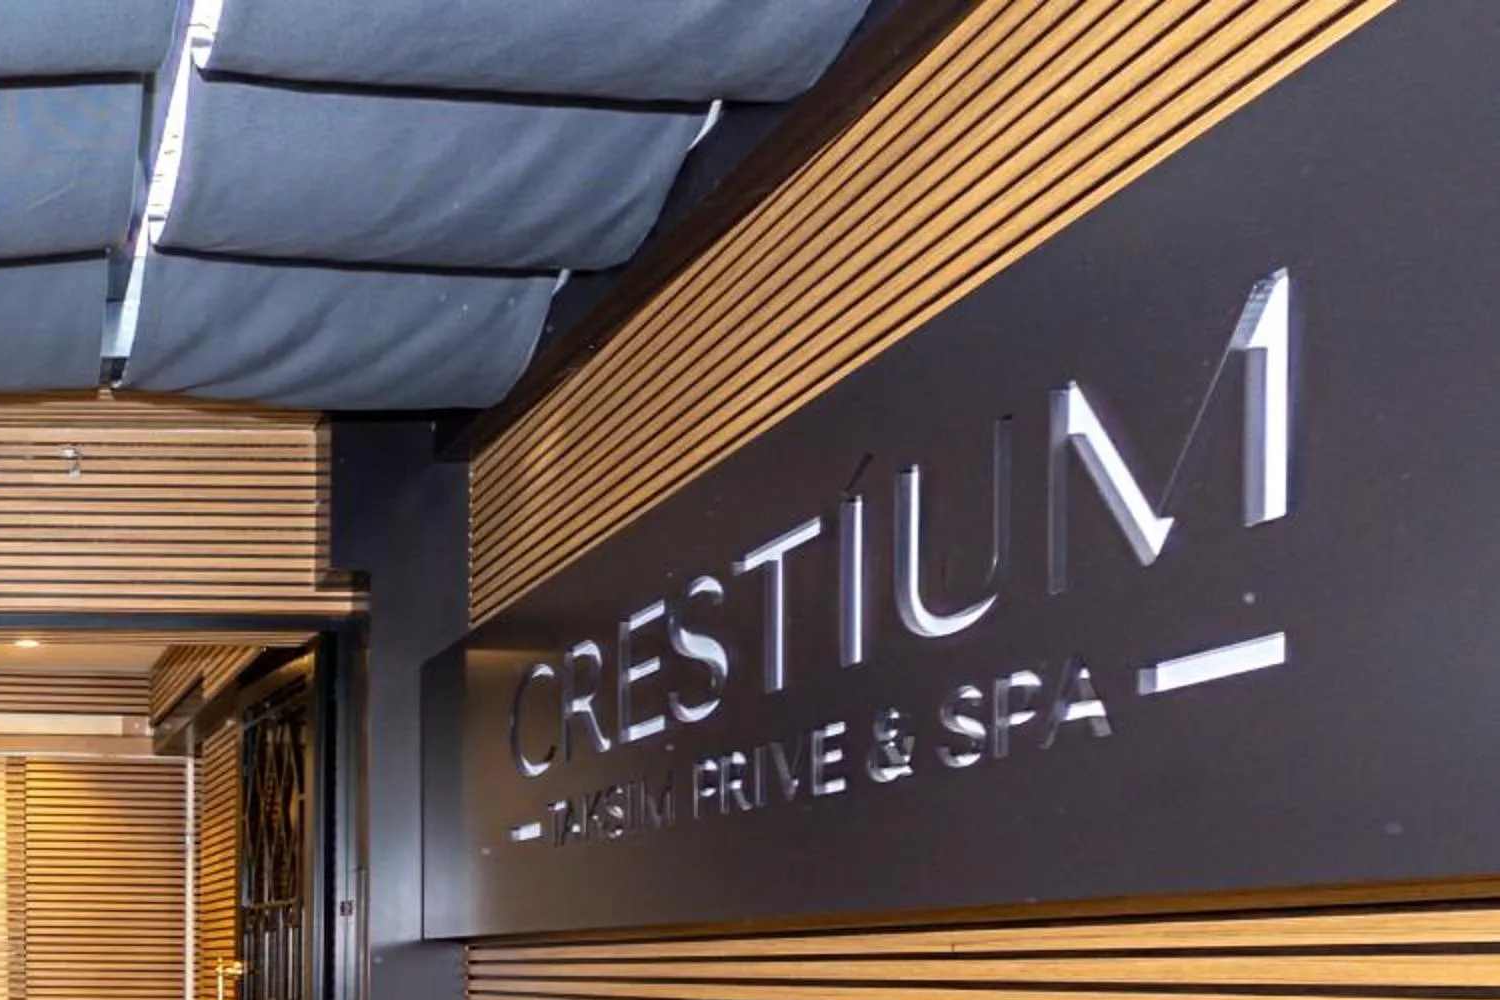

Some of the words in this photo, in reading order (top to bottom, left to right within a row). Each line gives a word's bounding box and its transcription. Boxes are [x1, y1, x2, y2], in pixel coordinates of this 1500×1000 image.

[548, 768, 676, 848] TAKSIM
[692, 720, 847, 820] PRIVE
[866, 706, 916, 784] &
[936, 655, 1113, 769] SPA
